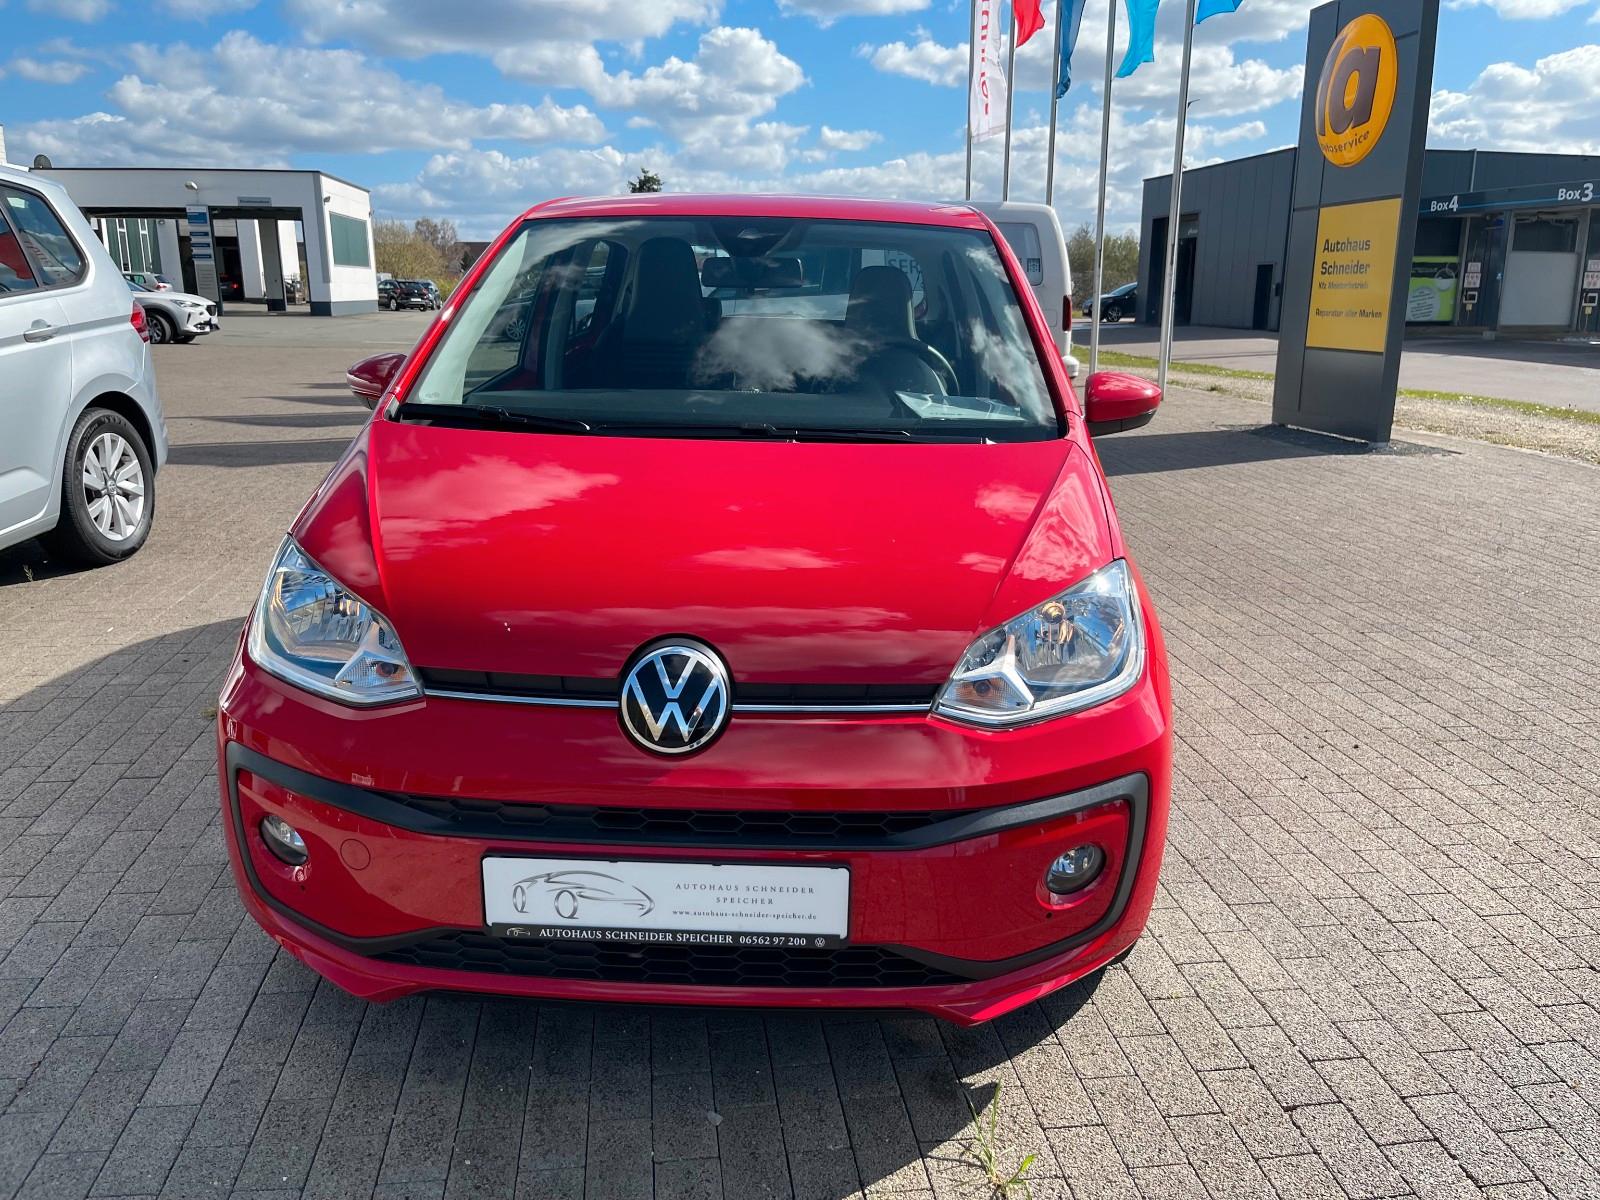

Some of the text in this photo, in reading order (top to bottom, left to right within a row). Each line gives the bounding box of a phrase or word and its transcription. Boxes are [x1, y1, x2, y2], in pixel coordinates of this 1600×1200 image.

[1322, 238, 1371, 253] Autohaus
[1320, 260, 1370, 276] Schneider
[1358, 308, 1382, 319] Marken
[675, 883, 815, 894] AUTOHAUS SCHNEIDER
[715, 896, 774, 905] SPEICHER
[672, 909, 817, 920] www.autohaus-schneider-speicher.de
[538, 928, 602, 939] AUTOHAUS
[605, 930, 673, 942] SCHNEIDER
[676, 932, 733, 944] SPEICHER
[739, 935, 770, 945] 06562
[772, 936, 785, 945] 97
[787, 937, 806, 946] 200
